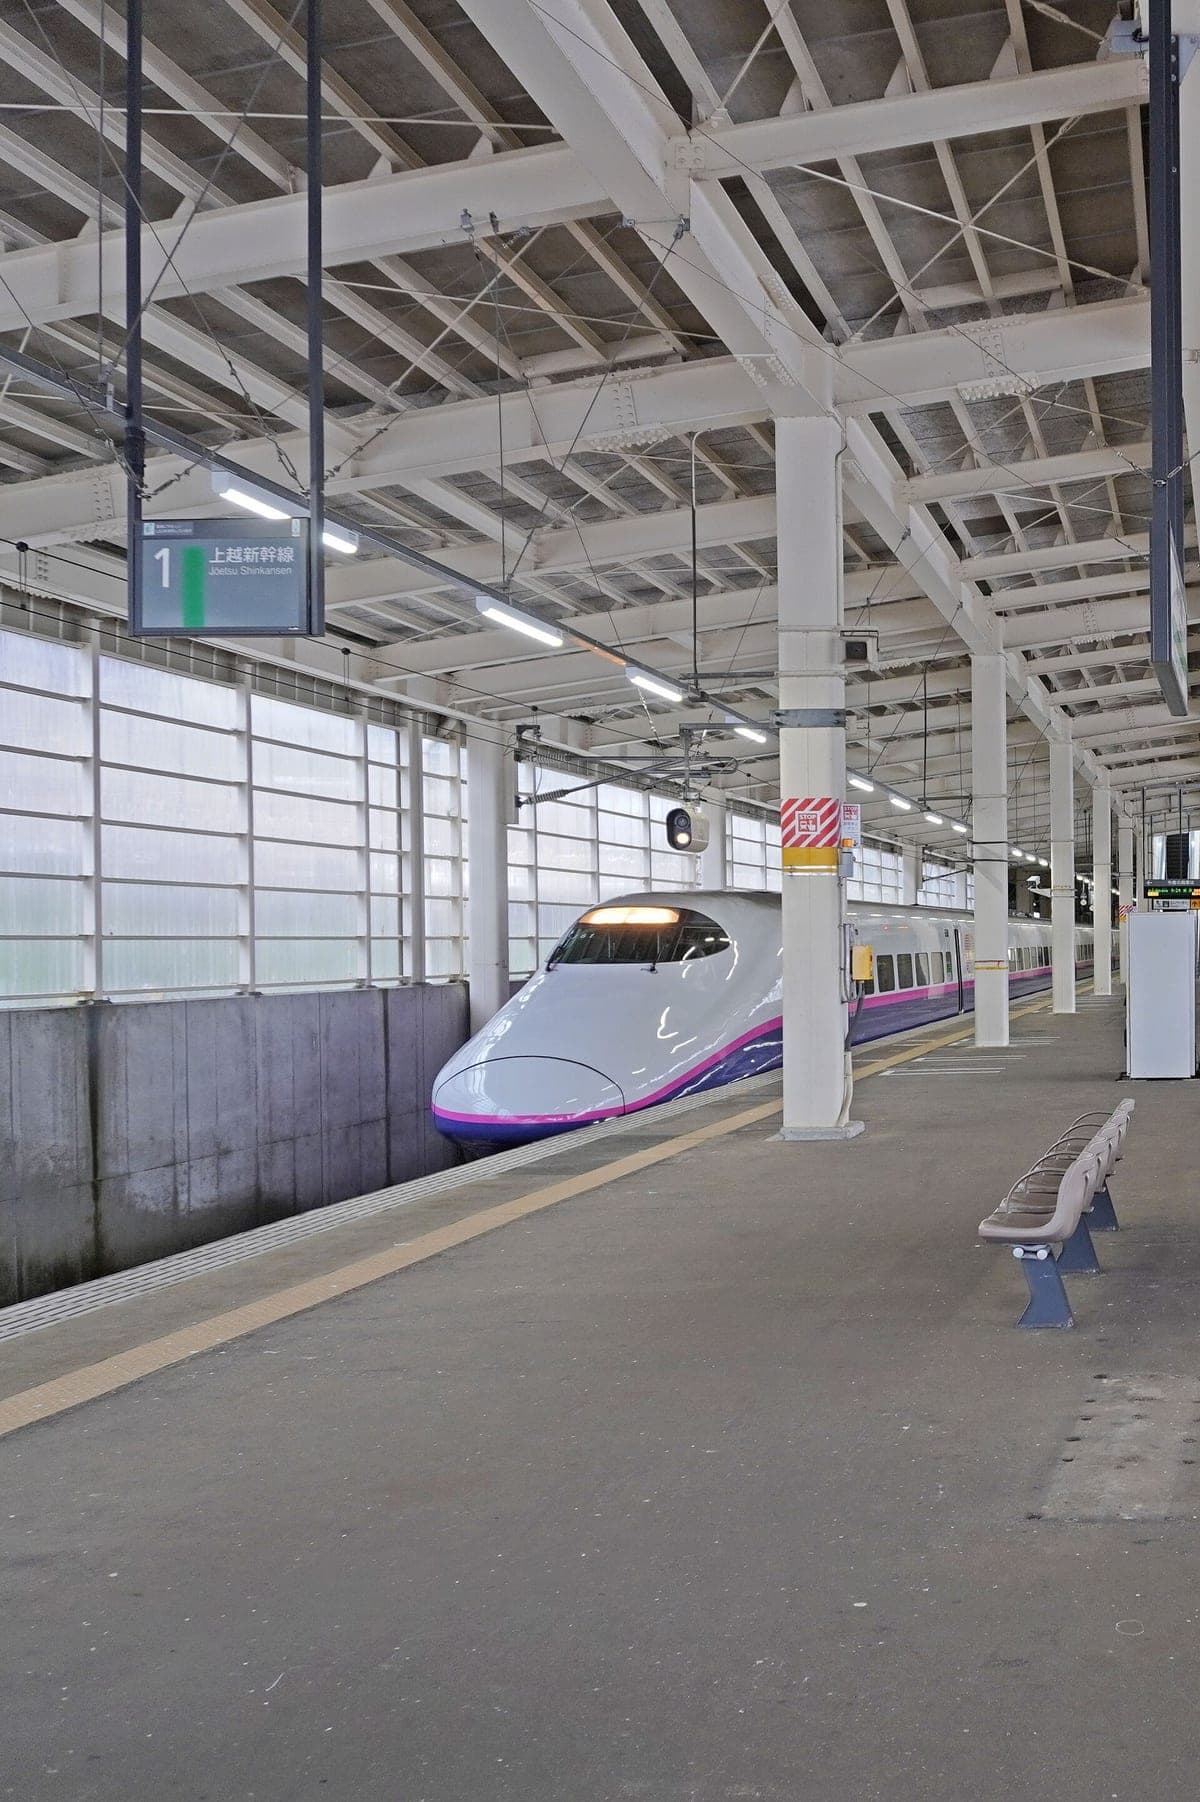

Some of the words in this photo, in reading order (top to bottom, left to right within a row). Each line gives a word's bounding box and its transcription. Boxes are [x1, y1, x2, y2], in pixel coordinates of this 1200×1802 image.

[208, 546, 295, 563] 上越新幹線
[154, 547, 170, 588] 1
[240, 565, 292, 575] Shinkansen
